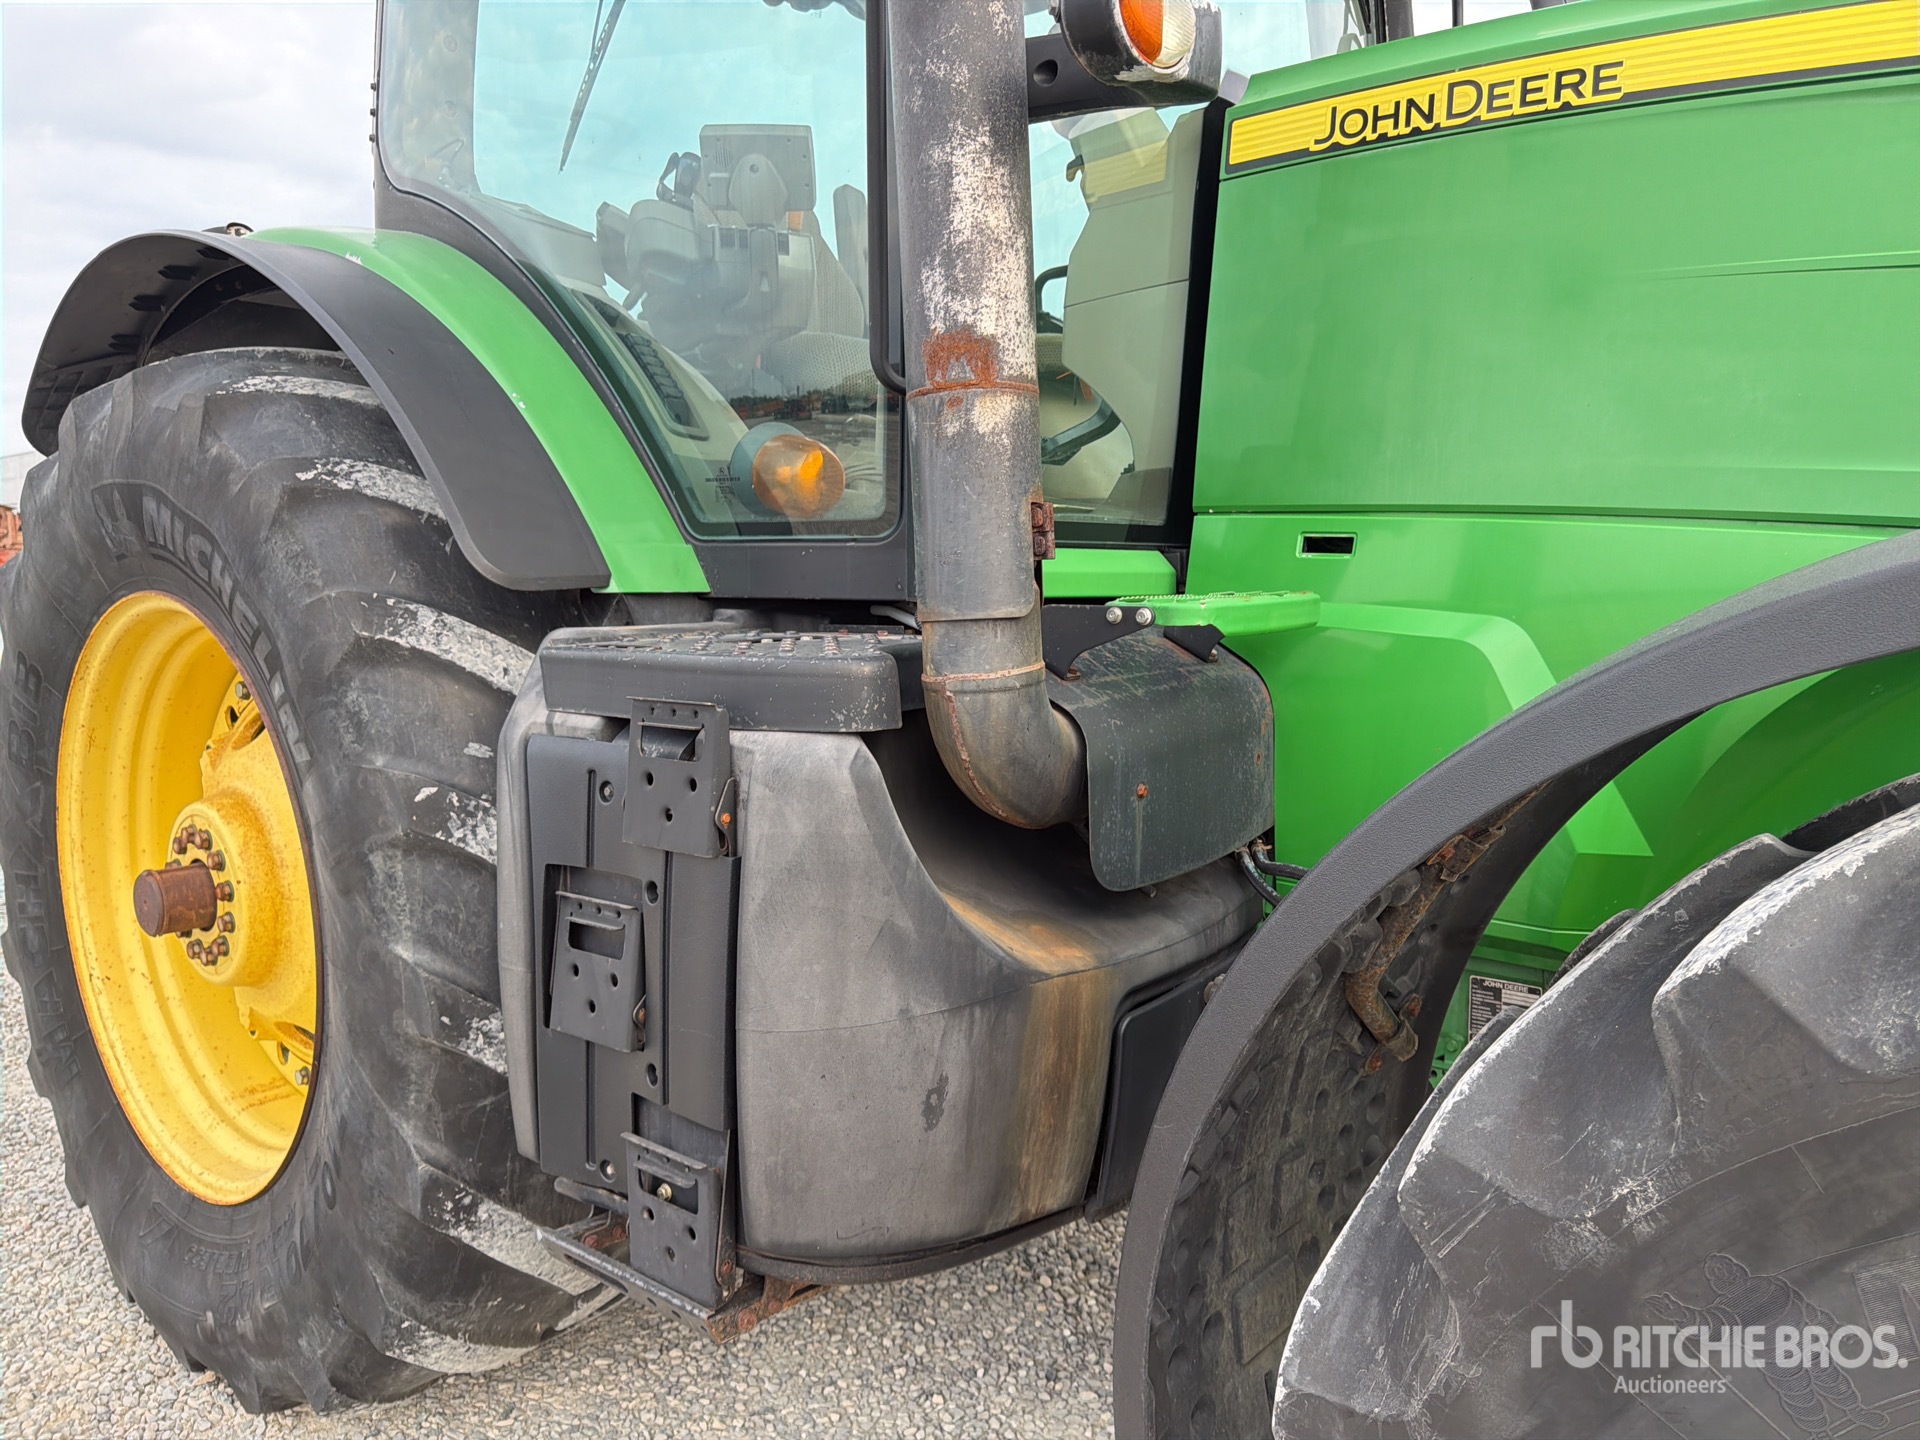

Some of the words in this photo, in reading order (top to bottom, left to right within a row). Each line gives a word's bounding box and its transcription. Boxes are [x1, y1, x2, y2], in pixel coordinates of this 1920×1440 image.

[1313, 92, 1436, 148] JOHN
[1446, 59, 1625, 121] DEERE
[142, 495, 311, 763] MICHELIN
[1482, 980, 1503, 989] JOHN
[1504, 984, 1529, 993] DEERE
